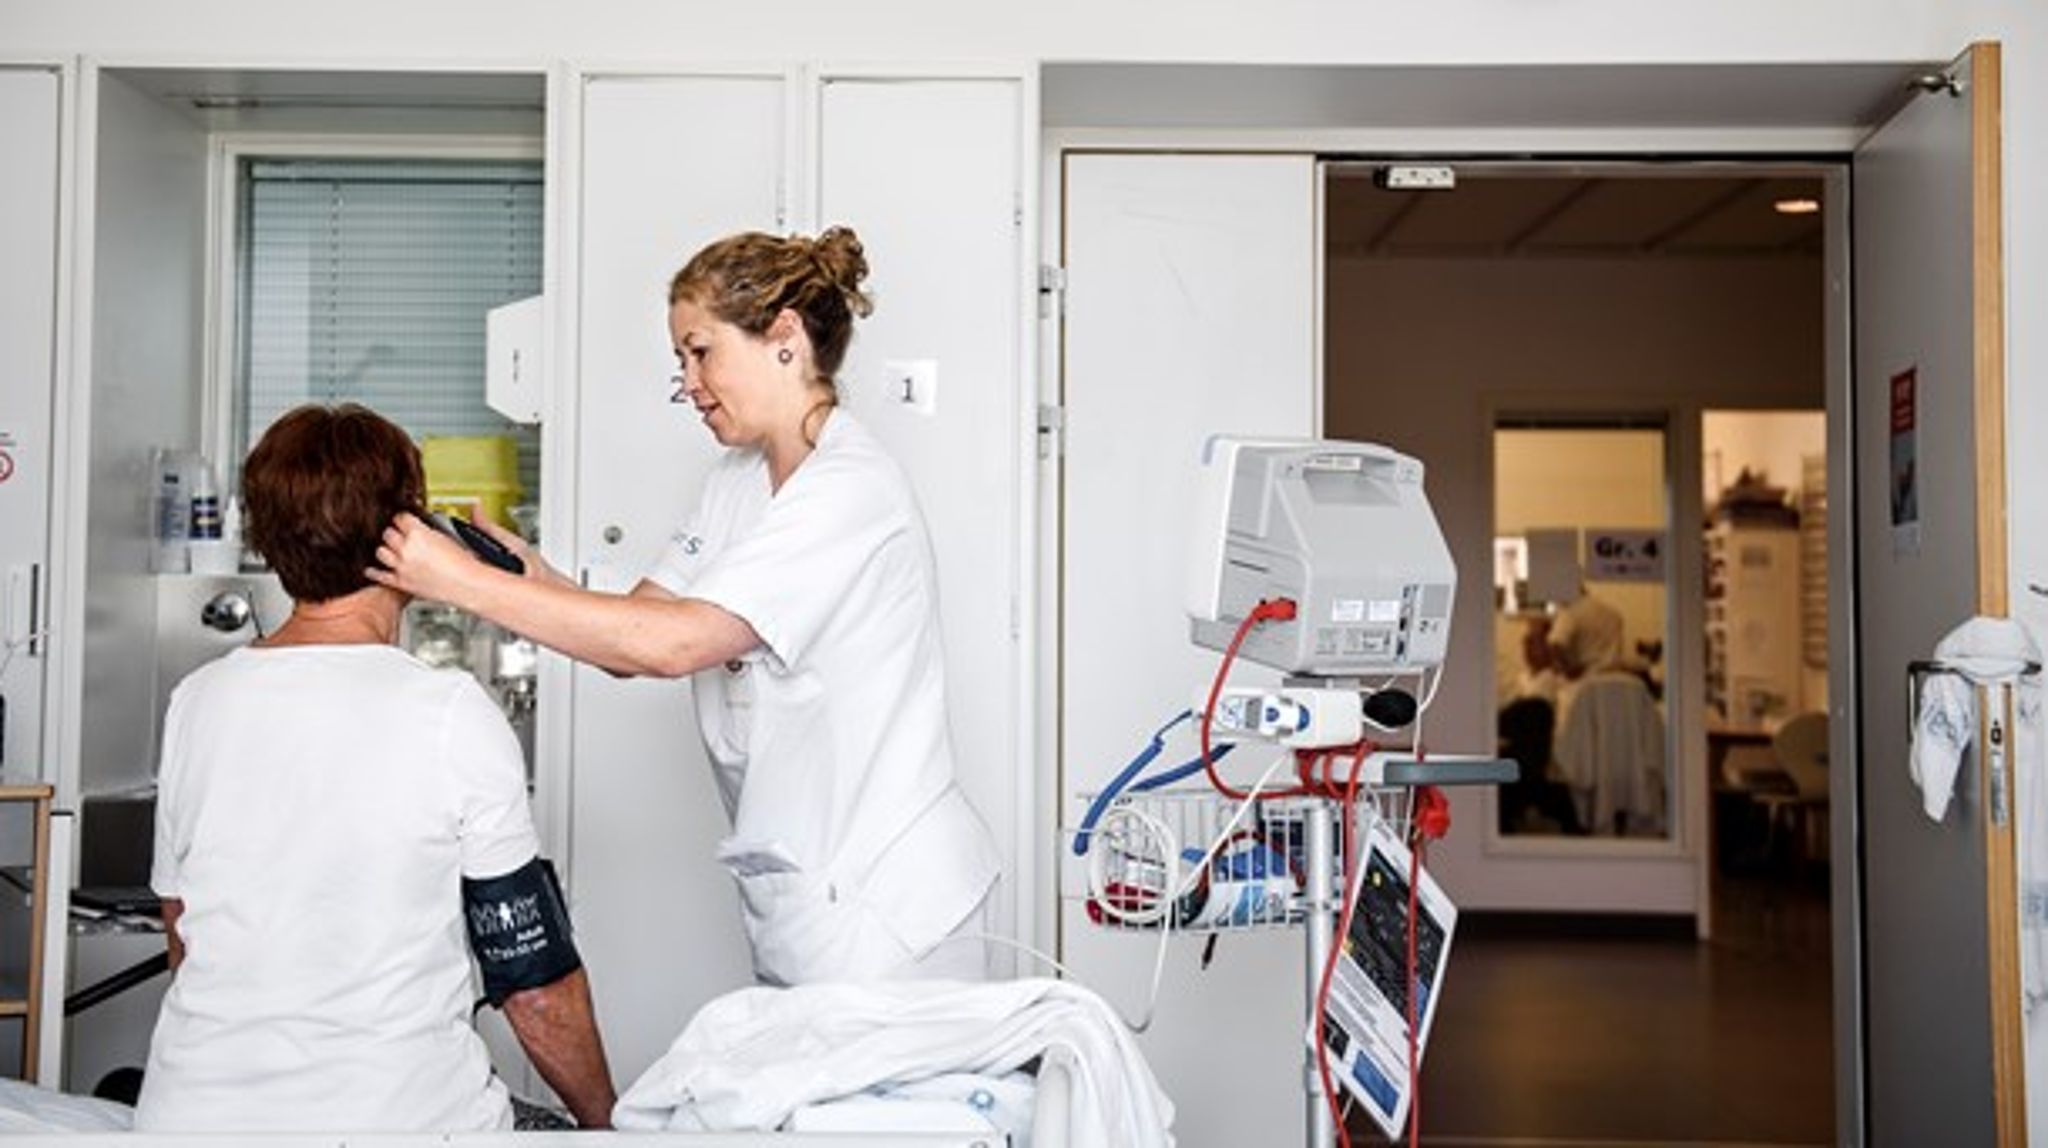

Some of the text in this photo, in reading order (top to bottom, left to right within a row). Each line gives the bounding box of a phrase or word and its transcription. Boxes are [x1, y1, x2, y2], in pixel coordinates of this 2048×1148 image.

[670, 375, 687, 403] 2
[901, 378, 914, 402] 1
[1595, 537, 1658, 558] Gr. 4
